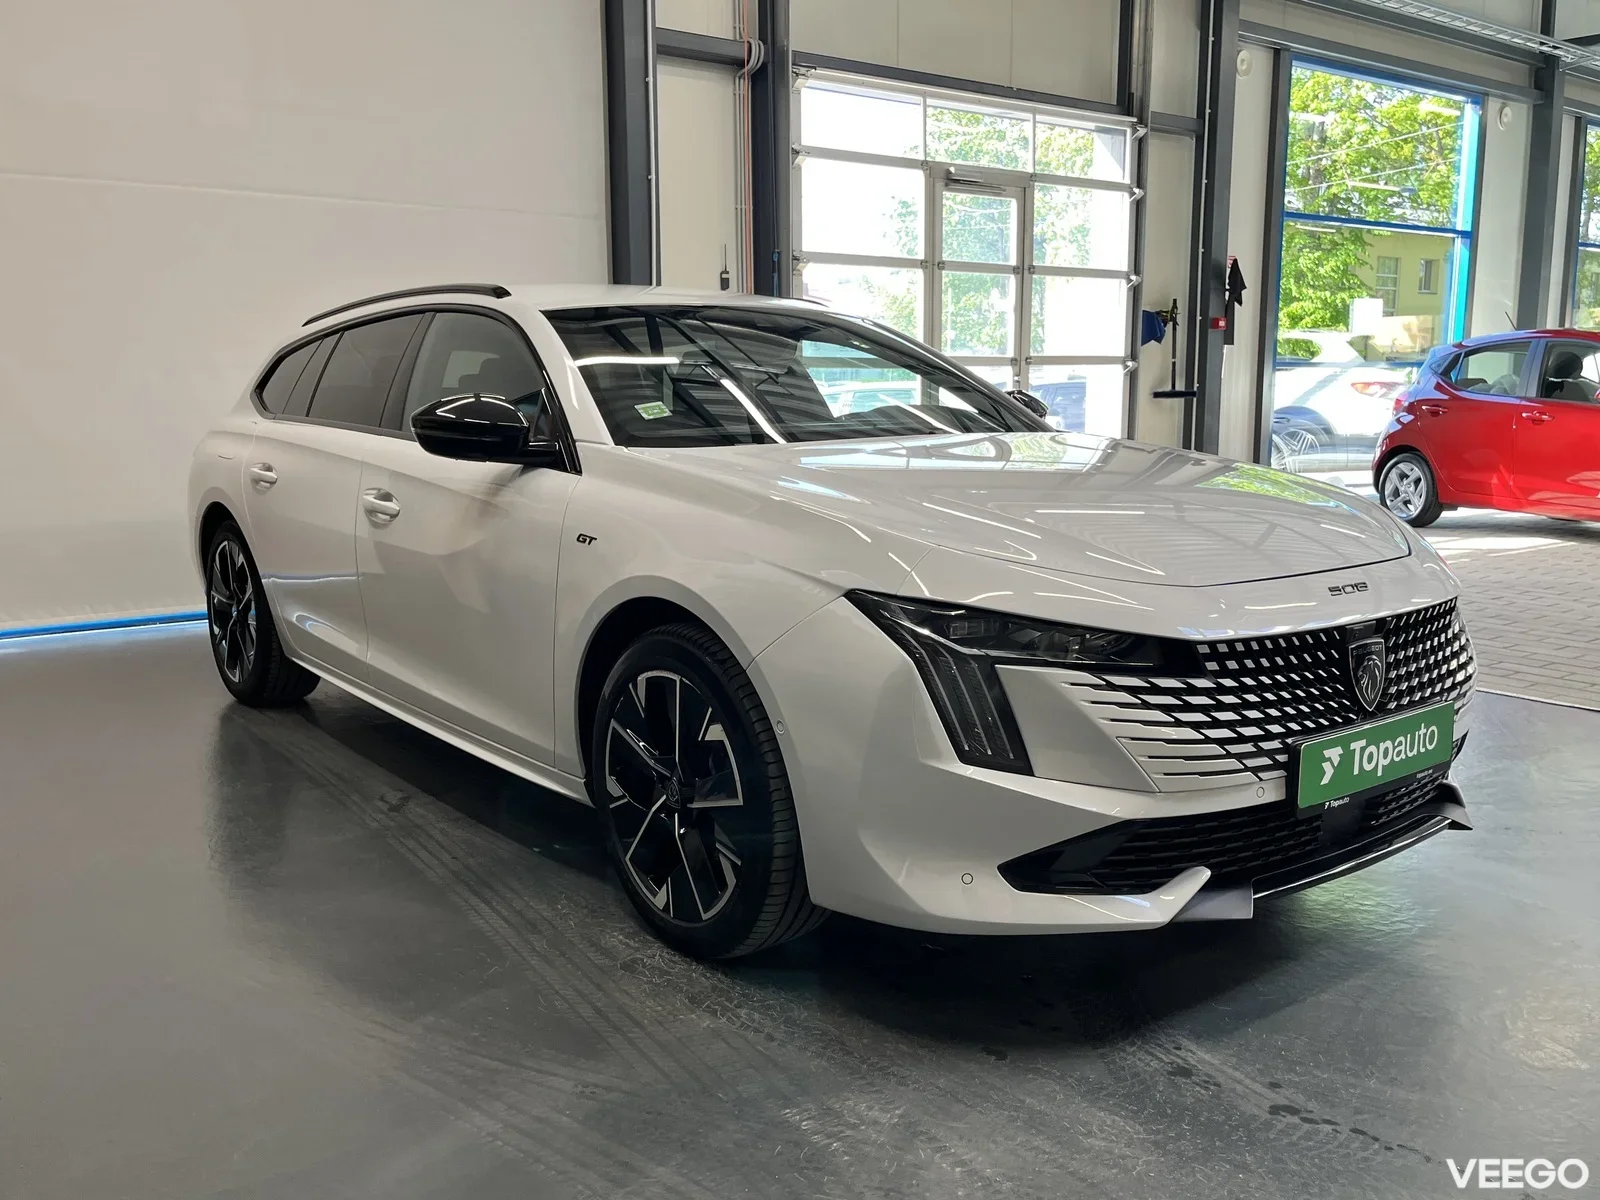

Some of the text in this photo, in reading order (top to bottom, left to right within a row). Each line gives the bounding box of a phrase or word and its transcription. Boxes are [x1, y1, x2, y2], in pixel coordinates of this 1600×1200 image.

[576, 533, 598, 546] GT
[1328, 581, 1369, 596] 508
[1350, 723, 1438, 776] Topauto
[1330, 797, 1350, 808] Topauto
